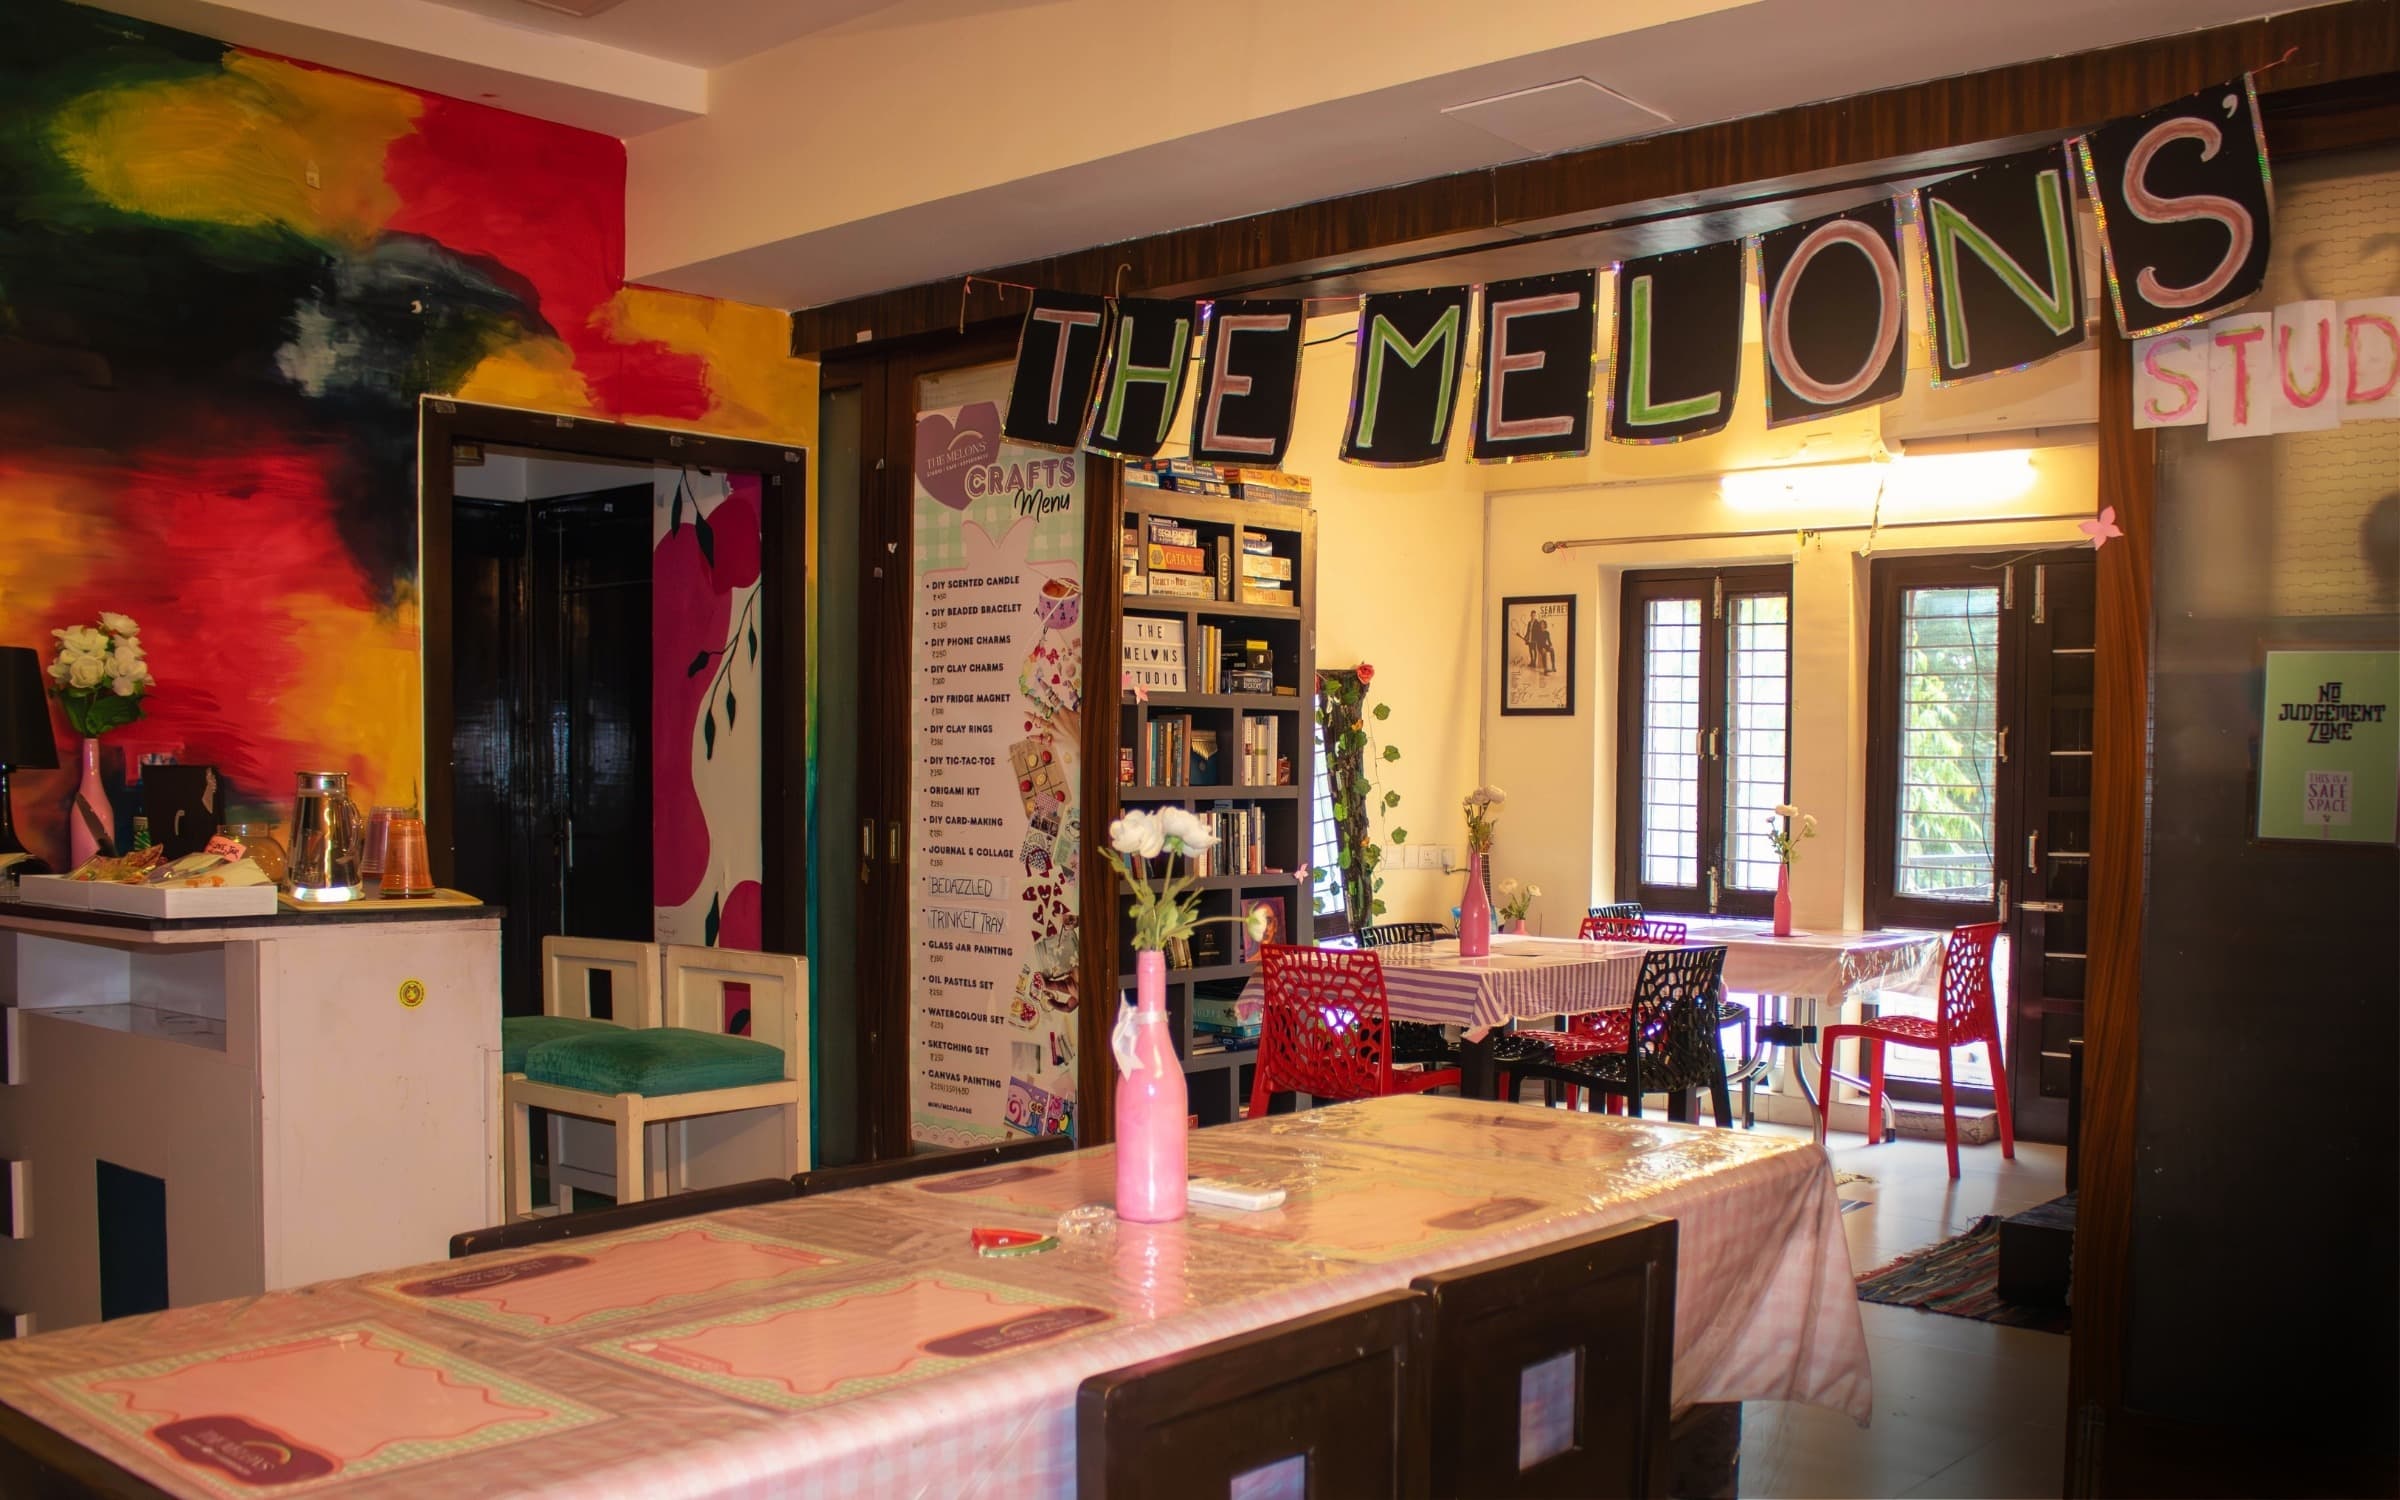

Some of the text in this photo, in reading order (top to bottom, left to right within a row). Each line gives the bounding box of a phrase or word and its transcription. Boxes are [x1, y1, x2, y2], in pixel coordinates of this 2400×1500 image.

[2144, 314, 2400, 427] STUD
[1033, 308, 1291, 455] THE
[966, 456, 1076, 497] CRAFTS
[1014, 488, 1070, 522] Menu
[932, 576, 1020, 590] DIY SCENTED CANDLE
[932, 604, 1022, 617] DIY BEADED BRACELET
[1137, 624, 1162, 639] THE
[931, 635, 1011, 647] DIY PHONE CHARMS
[930, 663, 1004, 674] DIY CLAY CHARMS
[930, 694, 1010, 704] DIY FRIDGE MAGNET
[2318, 682, 2343, 703] NO
[2278, 704, 2386, 722] JUDGEMENT
[930, 725, 992, 734] DIY CLAY RINGS
[2307, 722, 2352, 744] ZONE
[930, 757, 996, 766] DIY TIC-TAC-TOE
[2310, 773, 2329, 784] THIS
[930, 786, 980, 796] ORIGAMI KIT
[2308, 784, 2347, 798] SAFE
[2307, 799, 2347, 812] SPACE
[929, 816, 1003, 826] DIY CARD-MAKING
[929, 846, 966, 856] JOURNAL
[976, 848, 1014, 858] COLLAGE
[931, 876, 992, 898] BEDAZZLED
[930, 910, 1004, 934] TRINKET TRAY
[928, 940, 1013, 956] GLASS JAR PAINTING
[928, 974, 994, 990] OIL PASTELS SET
[928, 1007, 1004, 1025] WATERCOLOUR SET
[928, 1040, 989, 1056] SKETCHING SET
[928, 1070, 1002, 1088] CANVAS PAINTING
